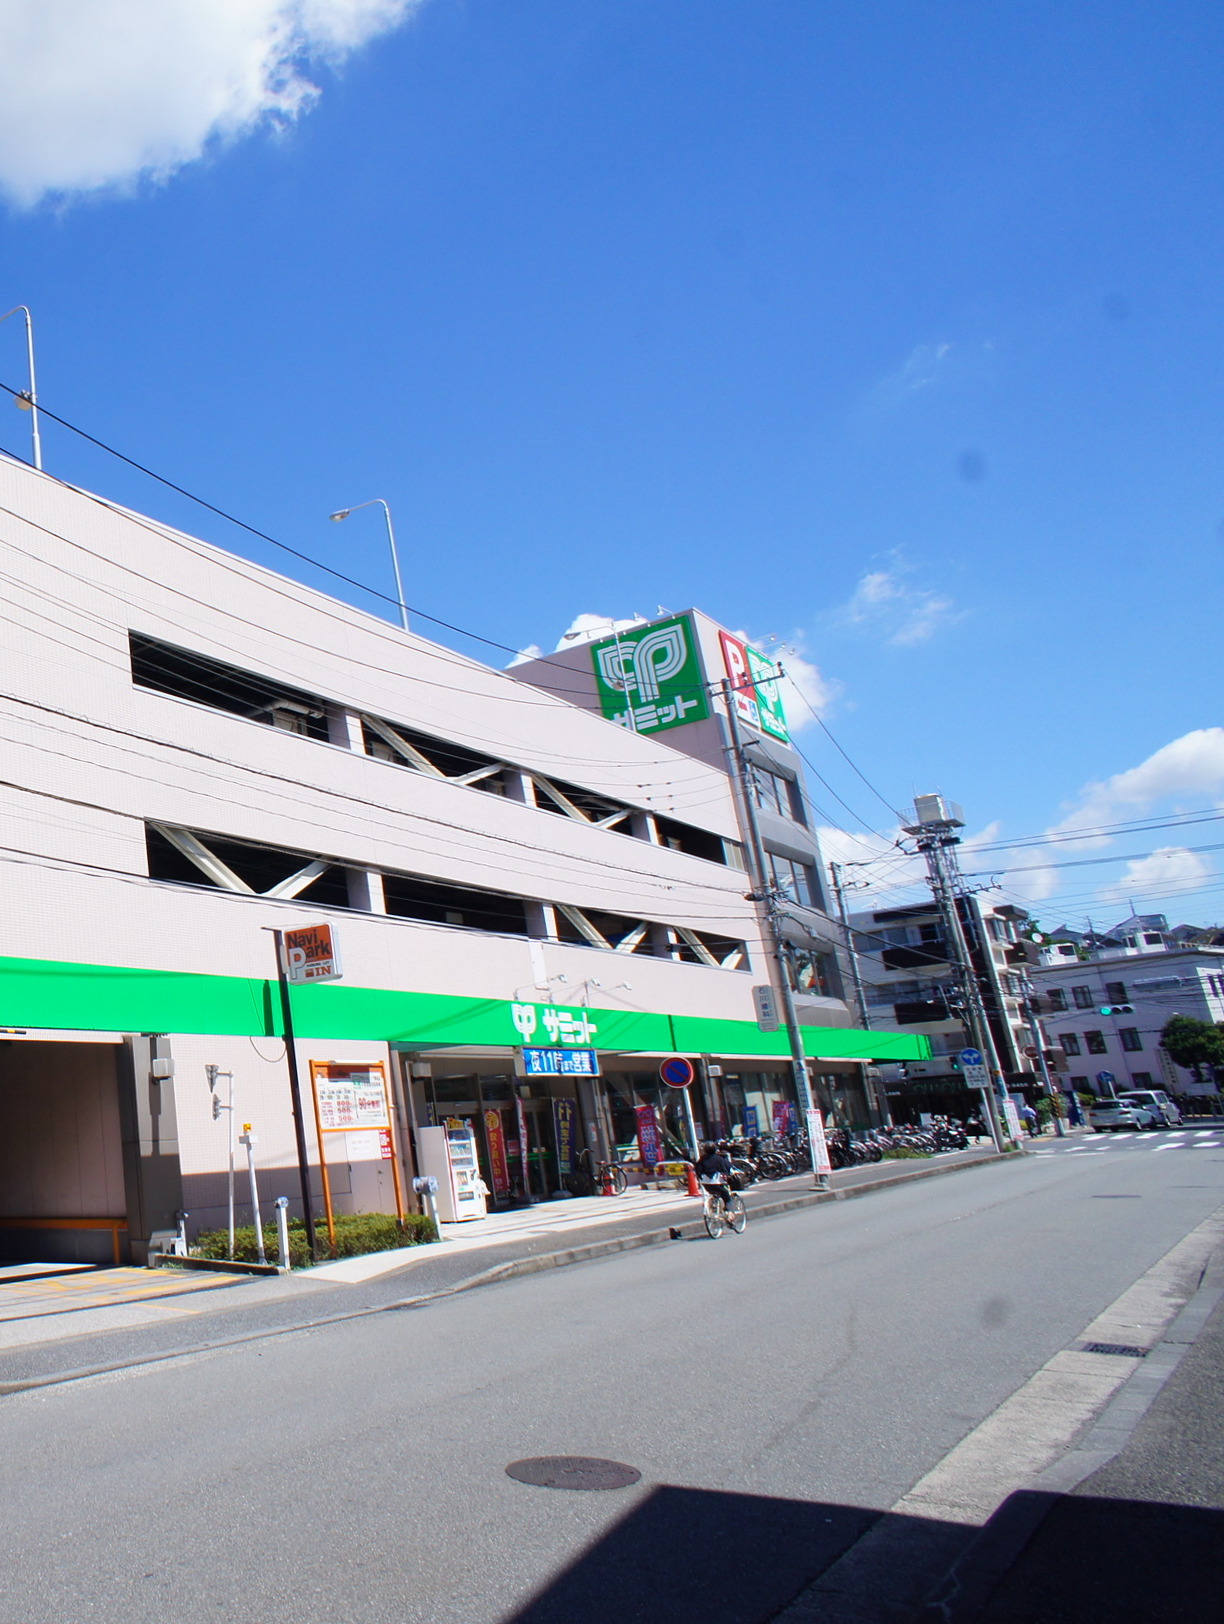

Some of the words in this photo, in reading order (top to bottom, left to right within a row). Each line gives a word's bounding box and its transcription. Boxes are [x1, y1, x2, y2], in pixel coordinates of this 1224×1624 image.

[287, 929, 318, 949] Navi
[315, 966, 332, 977] IN
[542, 1008, 598, 1044] サミット
